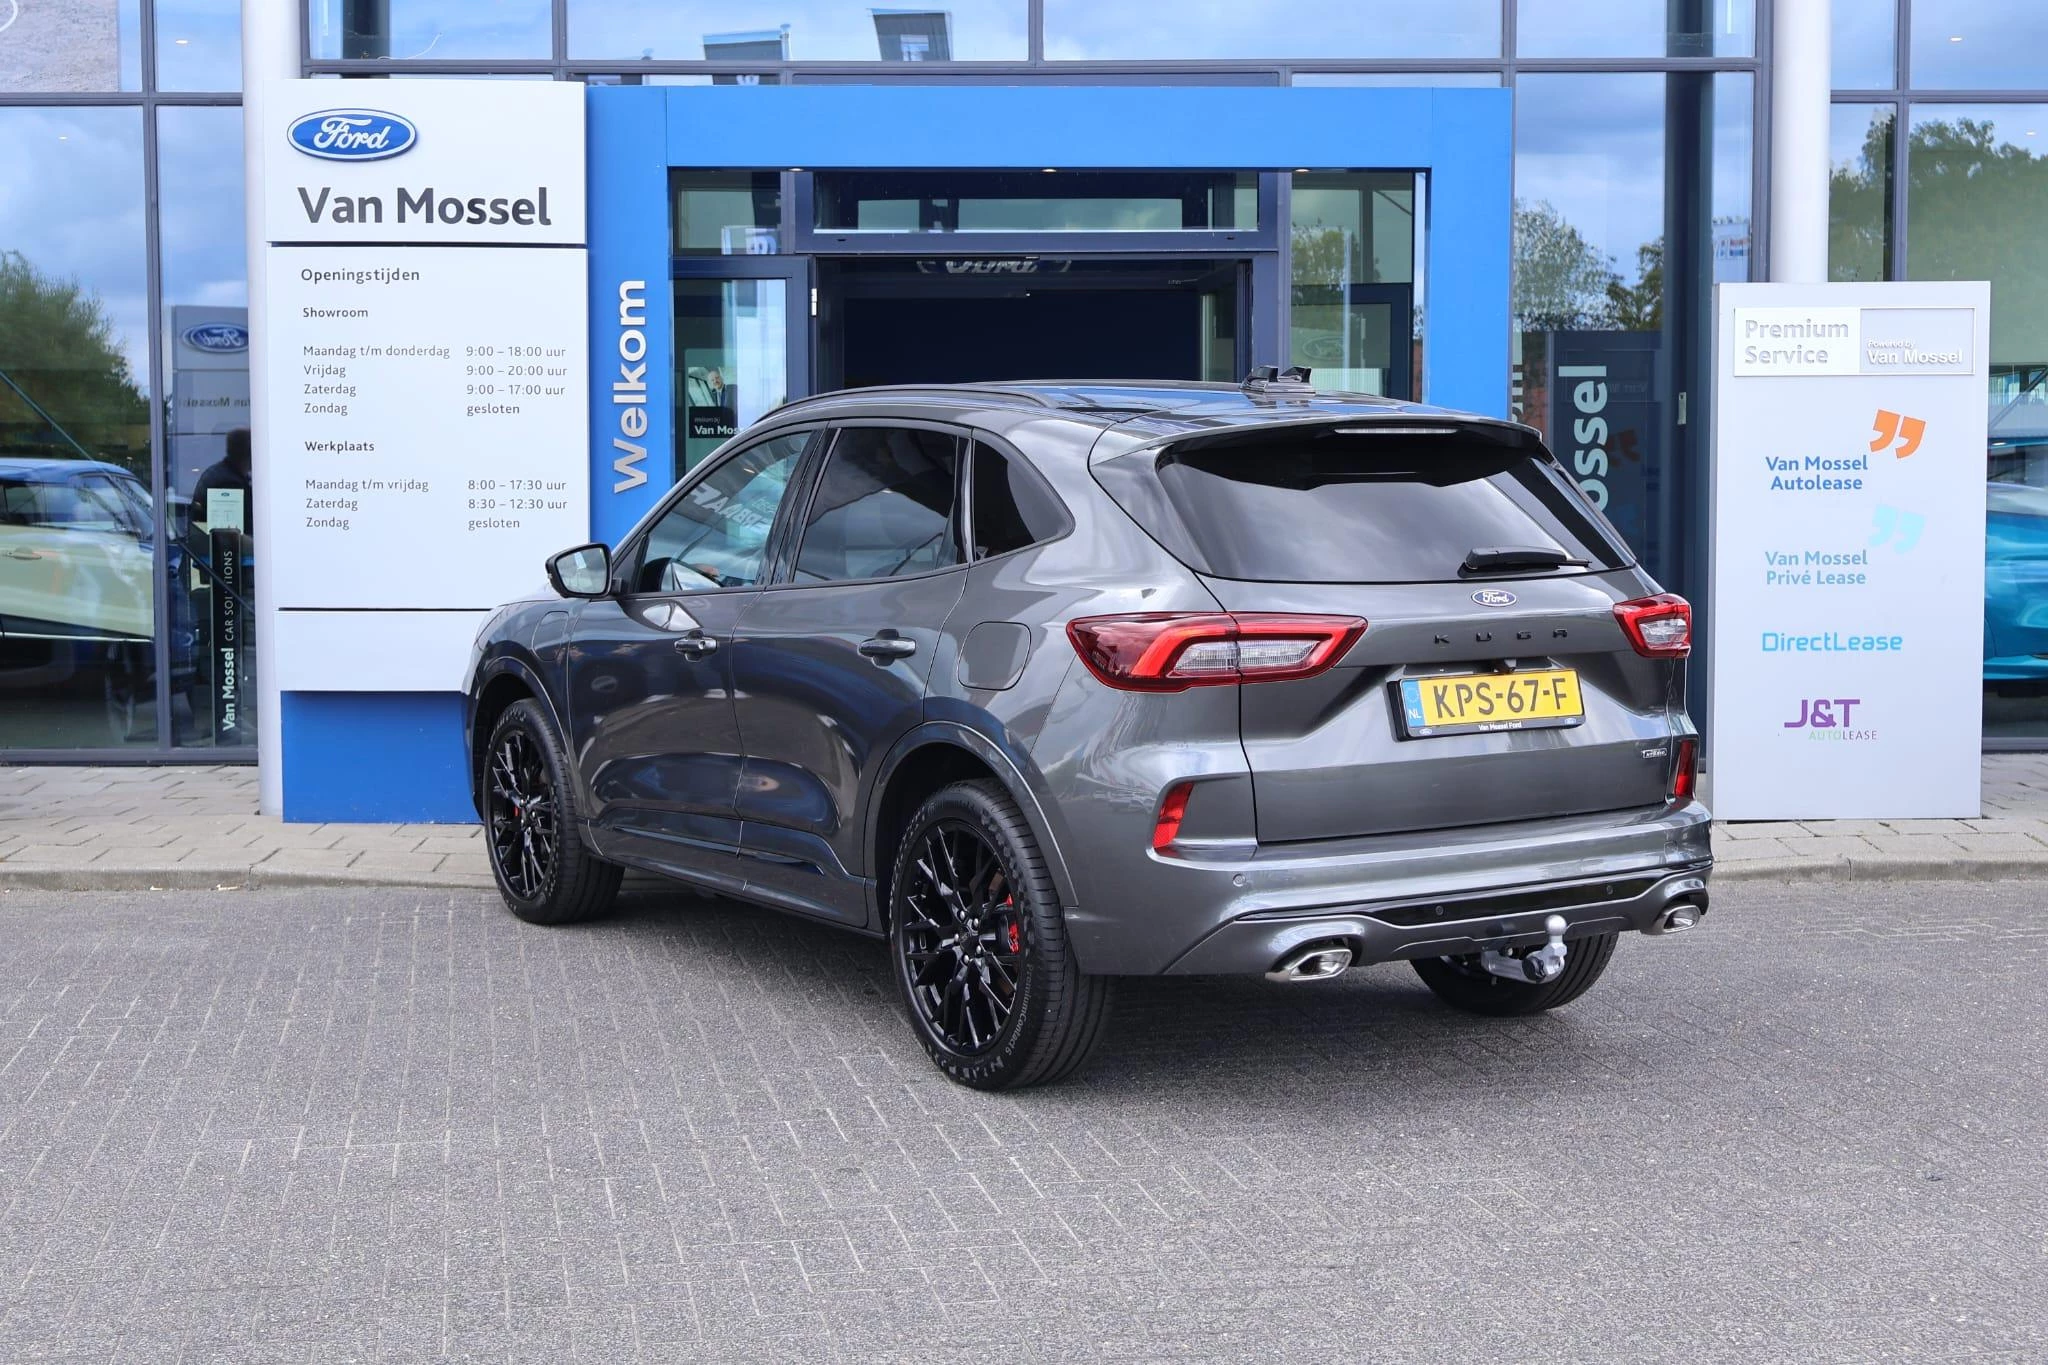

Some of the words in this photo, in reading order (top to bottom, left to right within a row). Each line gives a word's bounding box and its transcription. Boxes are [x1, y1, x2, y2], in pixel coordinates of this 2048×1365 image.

[313, 117, 391, 149] Ford
[297, 186, 383, 224] Van
[397, 186, 552, 226] Mossel
[301, 268, 420, 284] Openingstijden
[303, 307, 369, 318] Showroom
[1745, 319, 1849, 339] Premium
[303, 345, 356, 359] Maandag
[360, 345, 382, 357] t/m
[386, 345, 450, 359] donderdag
[466, 346, 494, 357] 9:00
[508, 346, 542, 357] 18:00
[546, 348, 566, 357] uur
[1745, 345, 1829, 364] Service
[1867, 350, 1898, 364] Van
[1903, 350, 1964, 365] Mossel
[304, 364, 346, 378] Vrijdag
[466, 365, 494, 376] 9:00
[508, 365, 543, 376] 20:00
[547, 367, 568, 376] uur
[304, 383, 356, 397] Zaterdag
[466, 384, 494, 395] 9:00
[508, 384, 541, 395] 17:00
[545, 386, 565, 395] uur
[613, 280, 648, 494] Welkom
[304, 402, 348, 416] Zondag
[467, 403, 520, 417] gesloten
[694, 425, 714, 434] Van
[1559, 366, 1608, 512] ossel
[305, 441, 375, 454] Werkplaats
[1765, 456, 1799, 470] Van
[1805, 455, 1868, 470] Mossel
[305, 479, 358, 493] Maandag
[362, 479, 384, 490] t/m
[388, 479, 429, 493] vrijdag
[468, 480, 496, 490] 8:00
[510, 480, 543, 490] 17:30
[546, 482, 567, 490] uur
[1771, 475, 1863, 490] Autolease
[306, 498, 358, 511] Zaterdag
[468, 499, 496, 509] 8:30
[510, 499, 544, 509] 12:30
[548, 501, 568, 509] uur
[306, 517, 350, 530] Zondag
[468, 517, 520, 531] gesloten
[1765, 551, 1799, 565] Van
[1805, 550, 1868, 565] Mossel
[223, 550, 233, 616] SOLTIONS
[1766, 570, 1811, 585] Privé
[1816, 571, 1866, 585] Lease
[224, 619, 234, 641] CAR
[1762, 632, 1903, 652] DirectLease
[221, 647, 234, 699] Mossel
[1433, 678, 1567, 719] KPS-67-F
[222, 702, 235, 731] Van
[1408, 708, 1421, 720] NL
[1784, 699, 1860, 728] J&T
[1808, 730, 1878, 741] AUTOLEASE
